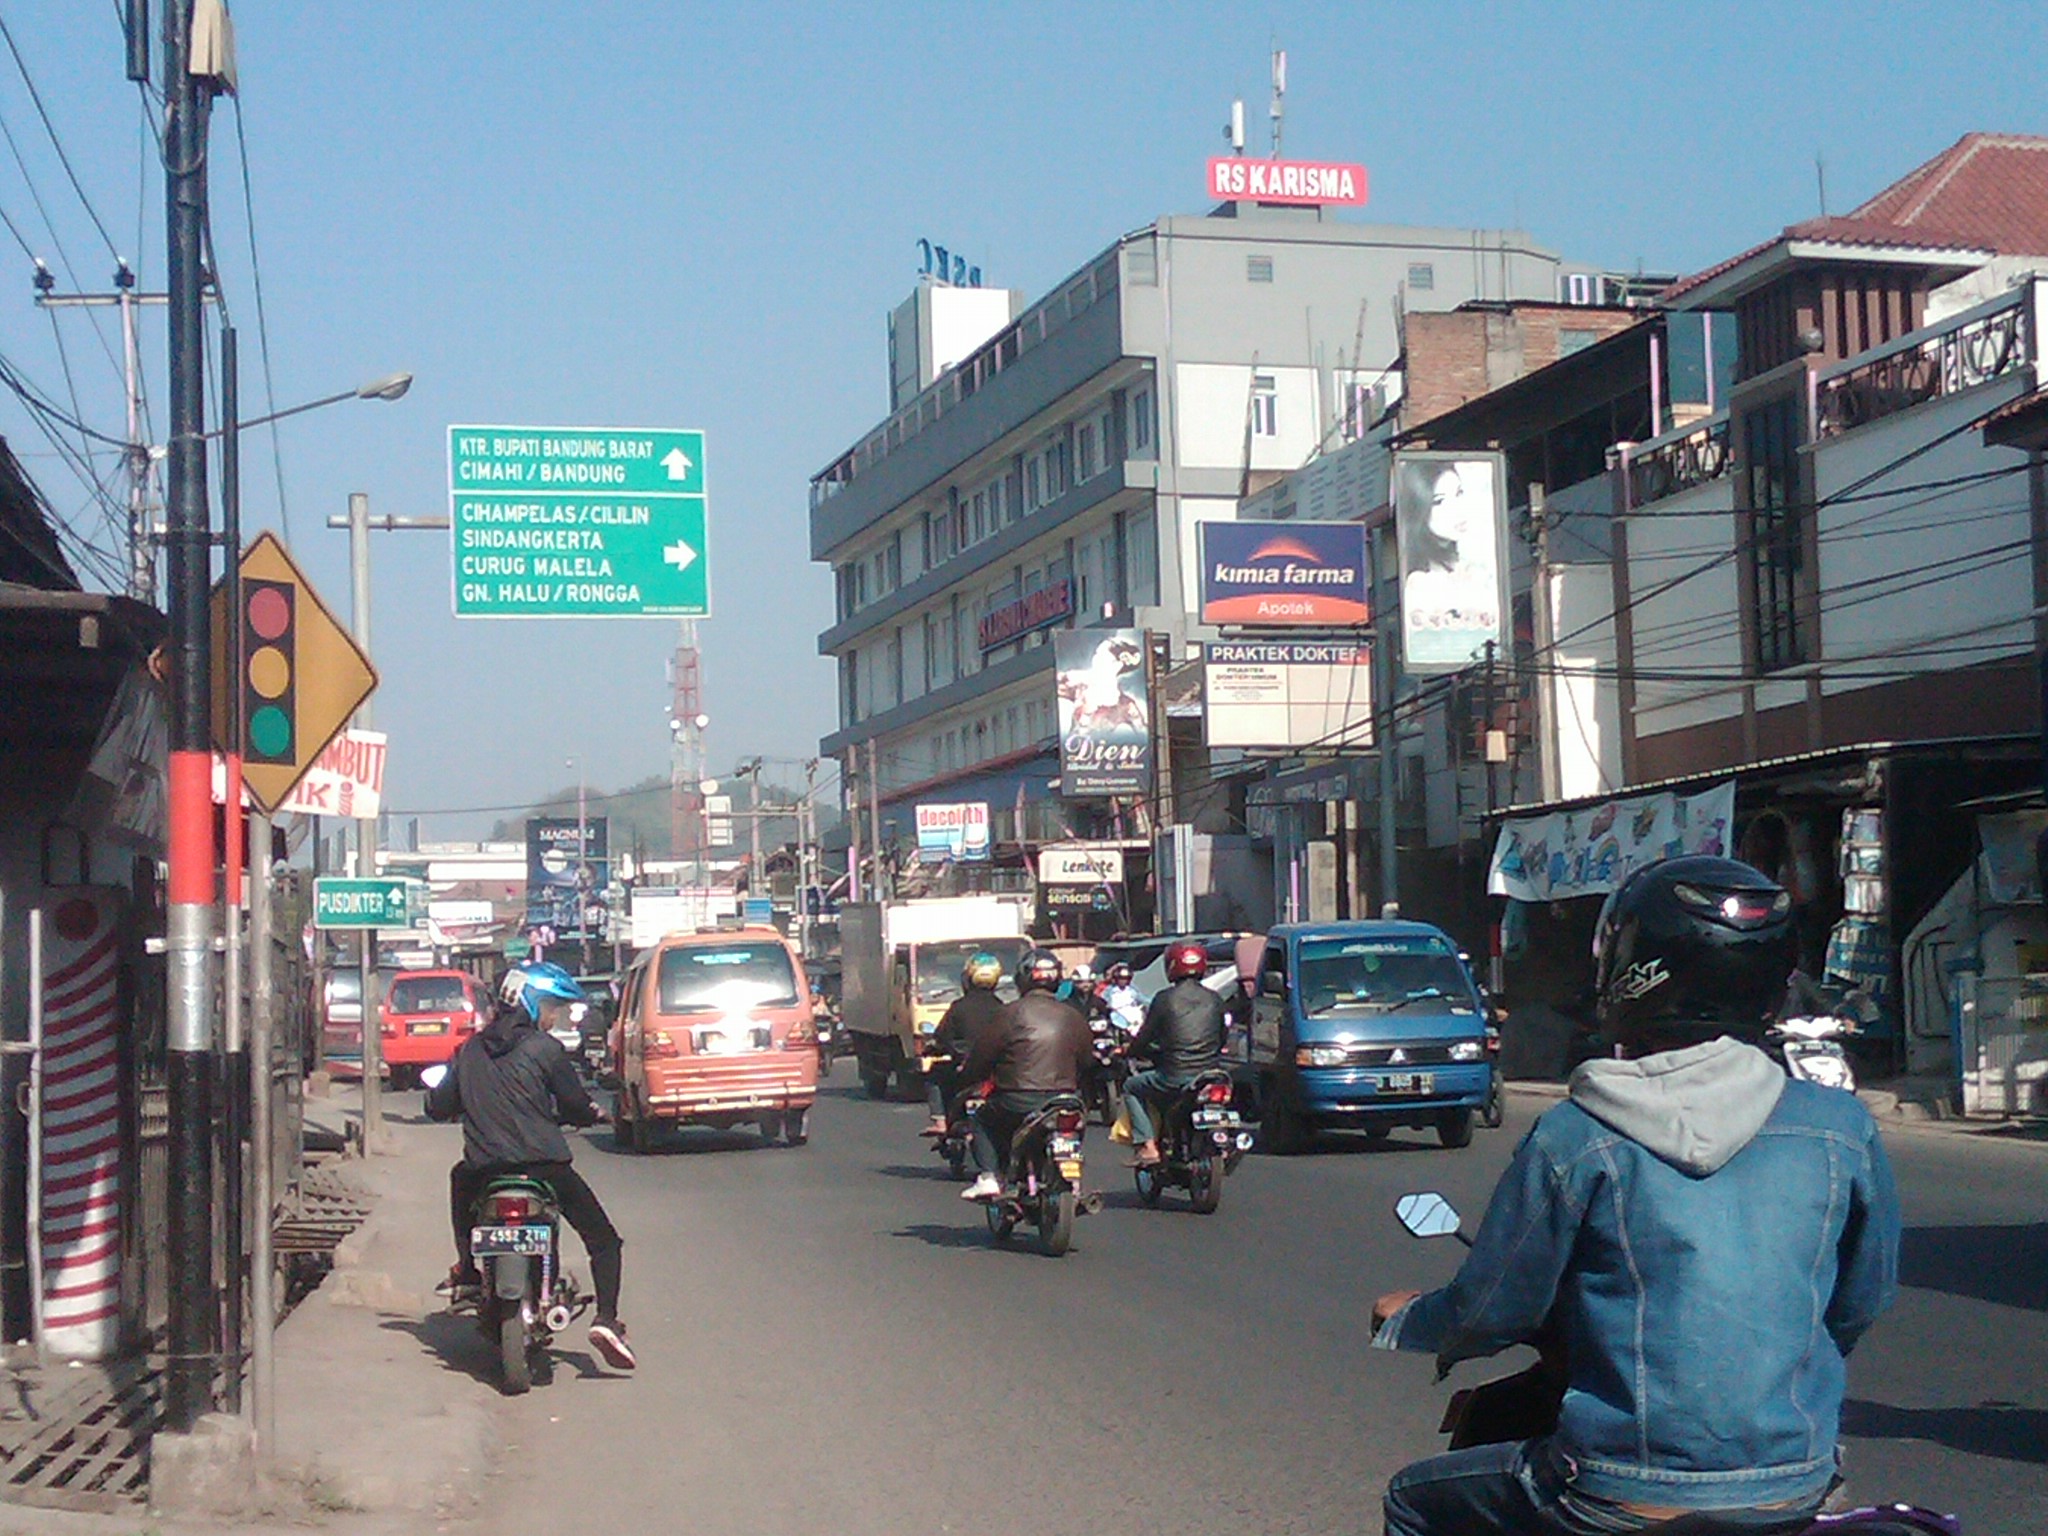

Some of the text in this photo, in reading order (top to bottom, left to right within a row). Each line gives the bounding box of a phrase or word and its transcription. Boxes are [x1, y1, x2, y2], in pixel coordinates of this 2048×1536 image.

[1215, 163, 1355, 198] RS KARISMA
[459, 437, 653, 459] KTR. BUPATI BANDUNG BARAT
[459, 462, 523, 481] CIMAHI
[540, 464, 626, 483] BANDUNG
[461, 529, 604, 550] SINDANGKERTA
[461, 556, 613, 577] CURUG MALELA
[1214, 563, 1355, 584] kimia farma
[461, 583, 492, 603] GN.
[1257, 601, 1314, 616] Apotek
[1211, 646, 1290, 661] PRAKTEK
[1064, 734, 1147, 761] Dien
[920, 806, 984, 827] decolith
[318, 892, 384, 913] PUSDIKTER
